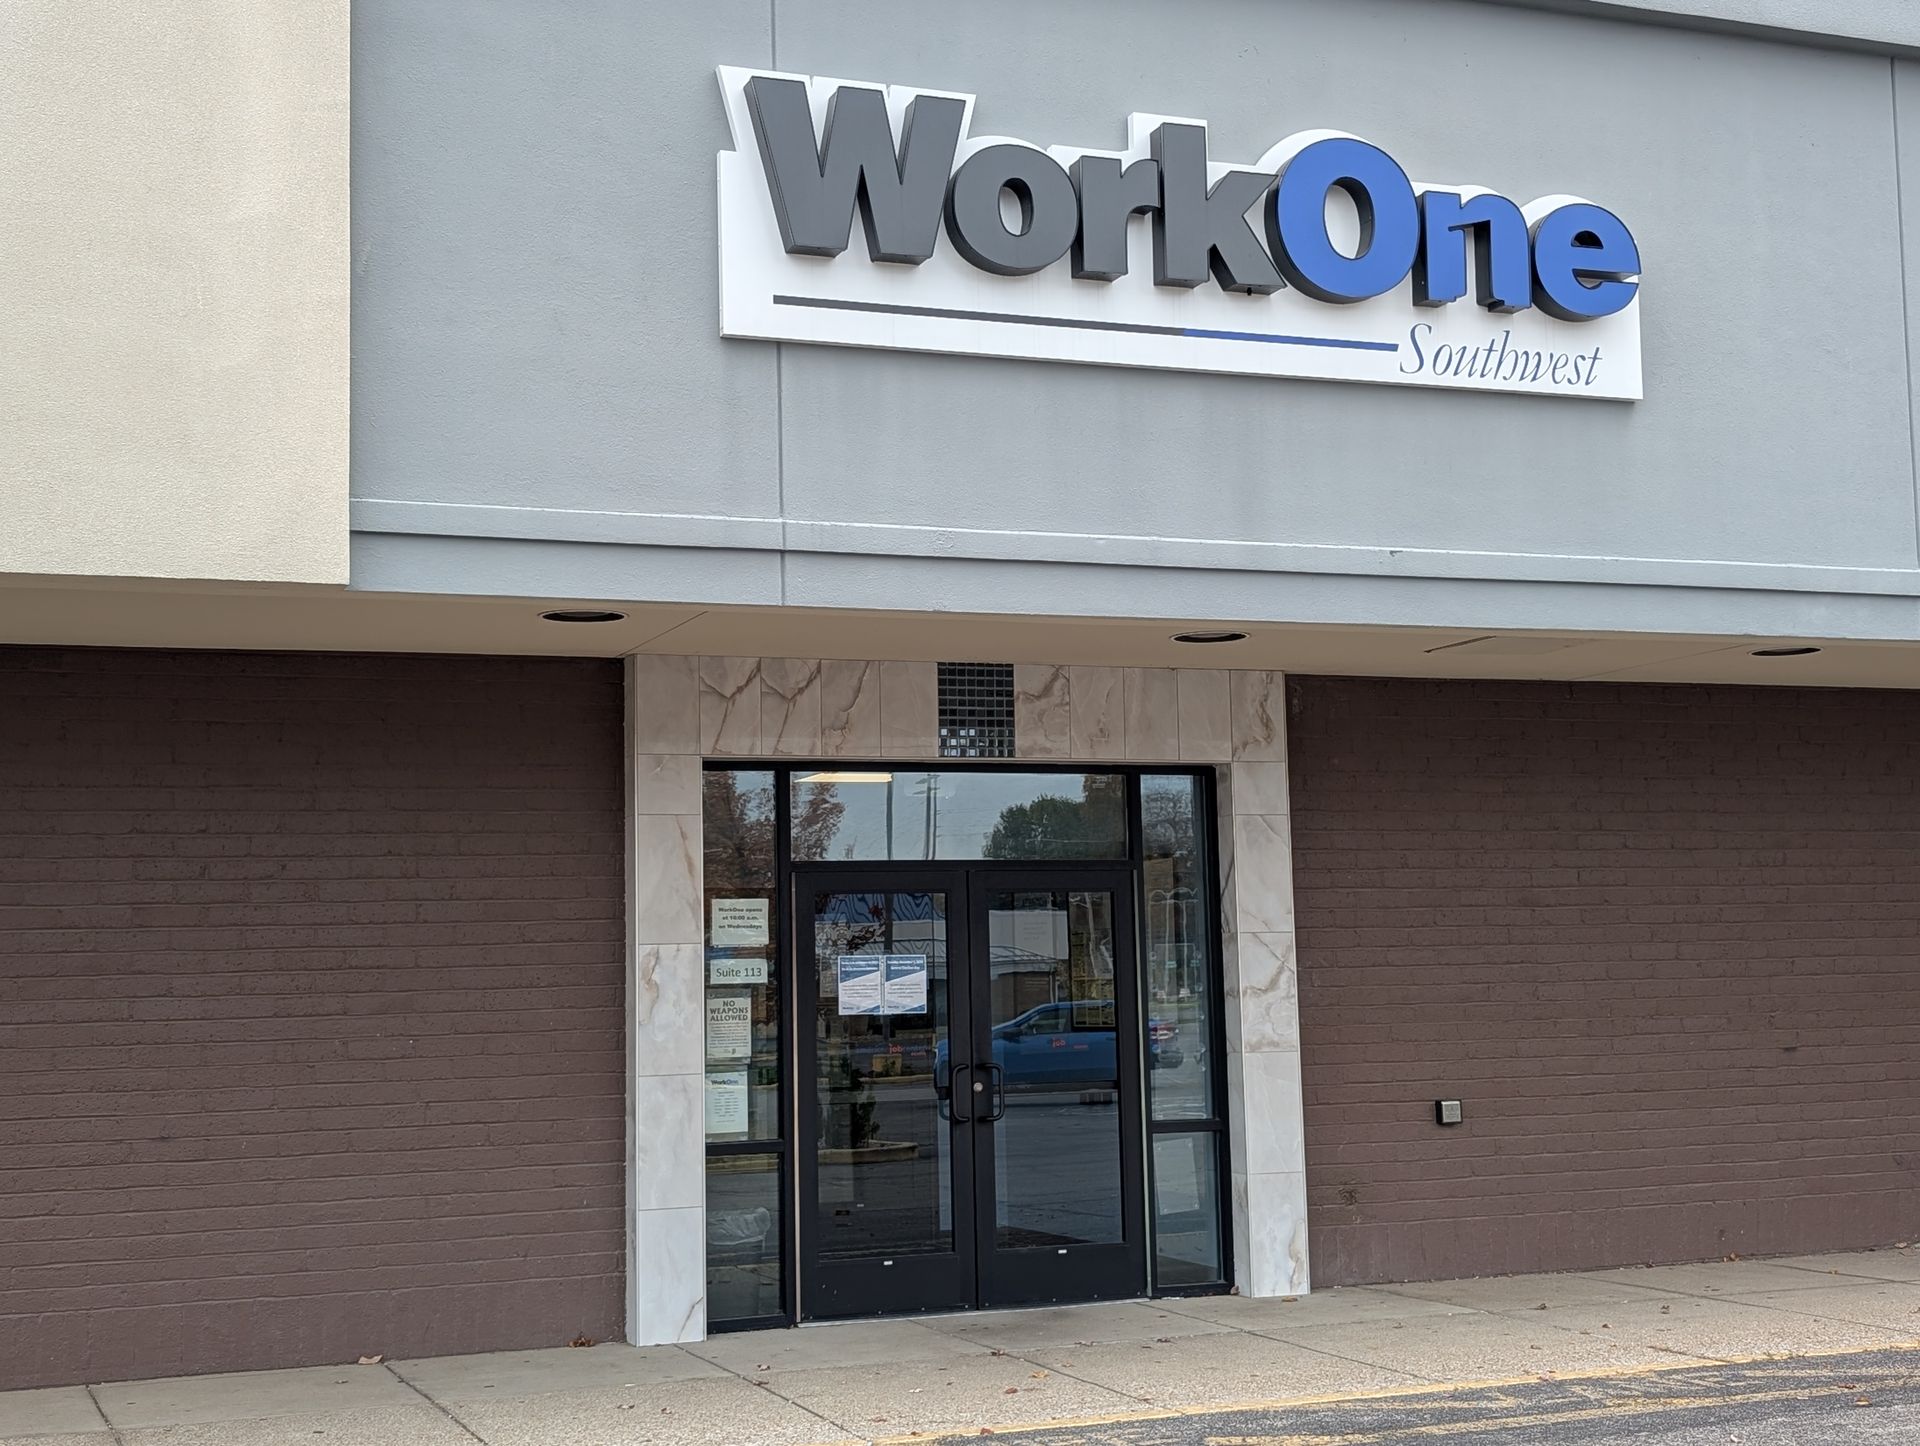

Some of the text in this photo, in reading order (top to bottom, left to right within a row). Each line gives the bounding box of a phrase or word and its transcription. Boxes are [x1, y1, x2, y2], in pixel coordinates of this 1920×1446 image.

[743, 75, 1642, 322] WorkOne
[1399, 322, 1604, 386] Southwest
[716, 967, 762, 978] Suite 113
[709, 1007, 749, 1015] WEAPONS
[710, 1014, 748, 1022] ALLOWED
